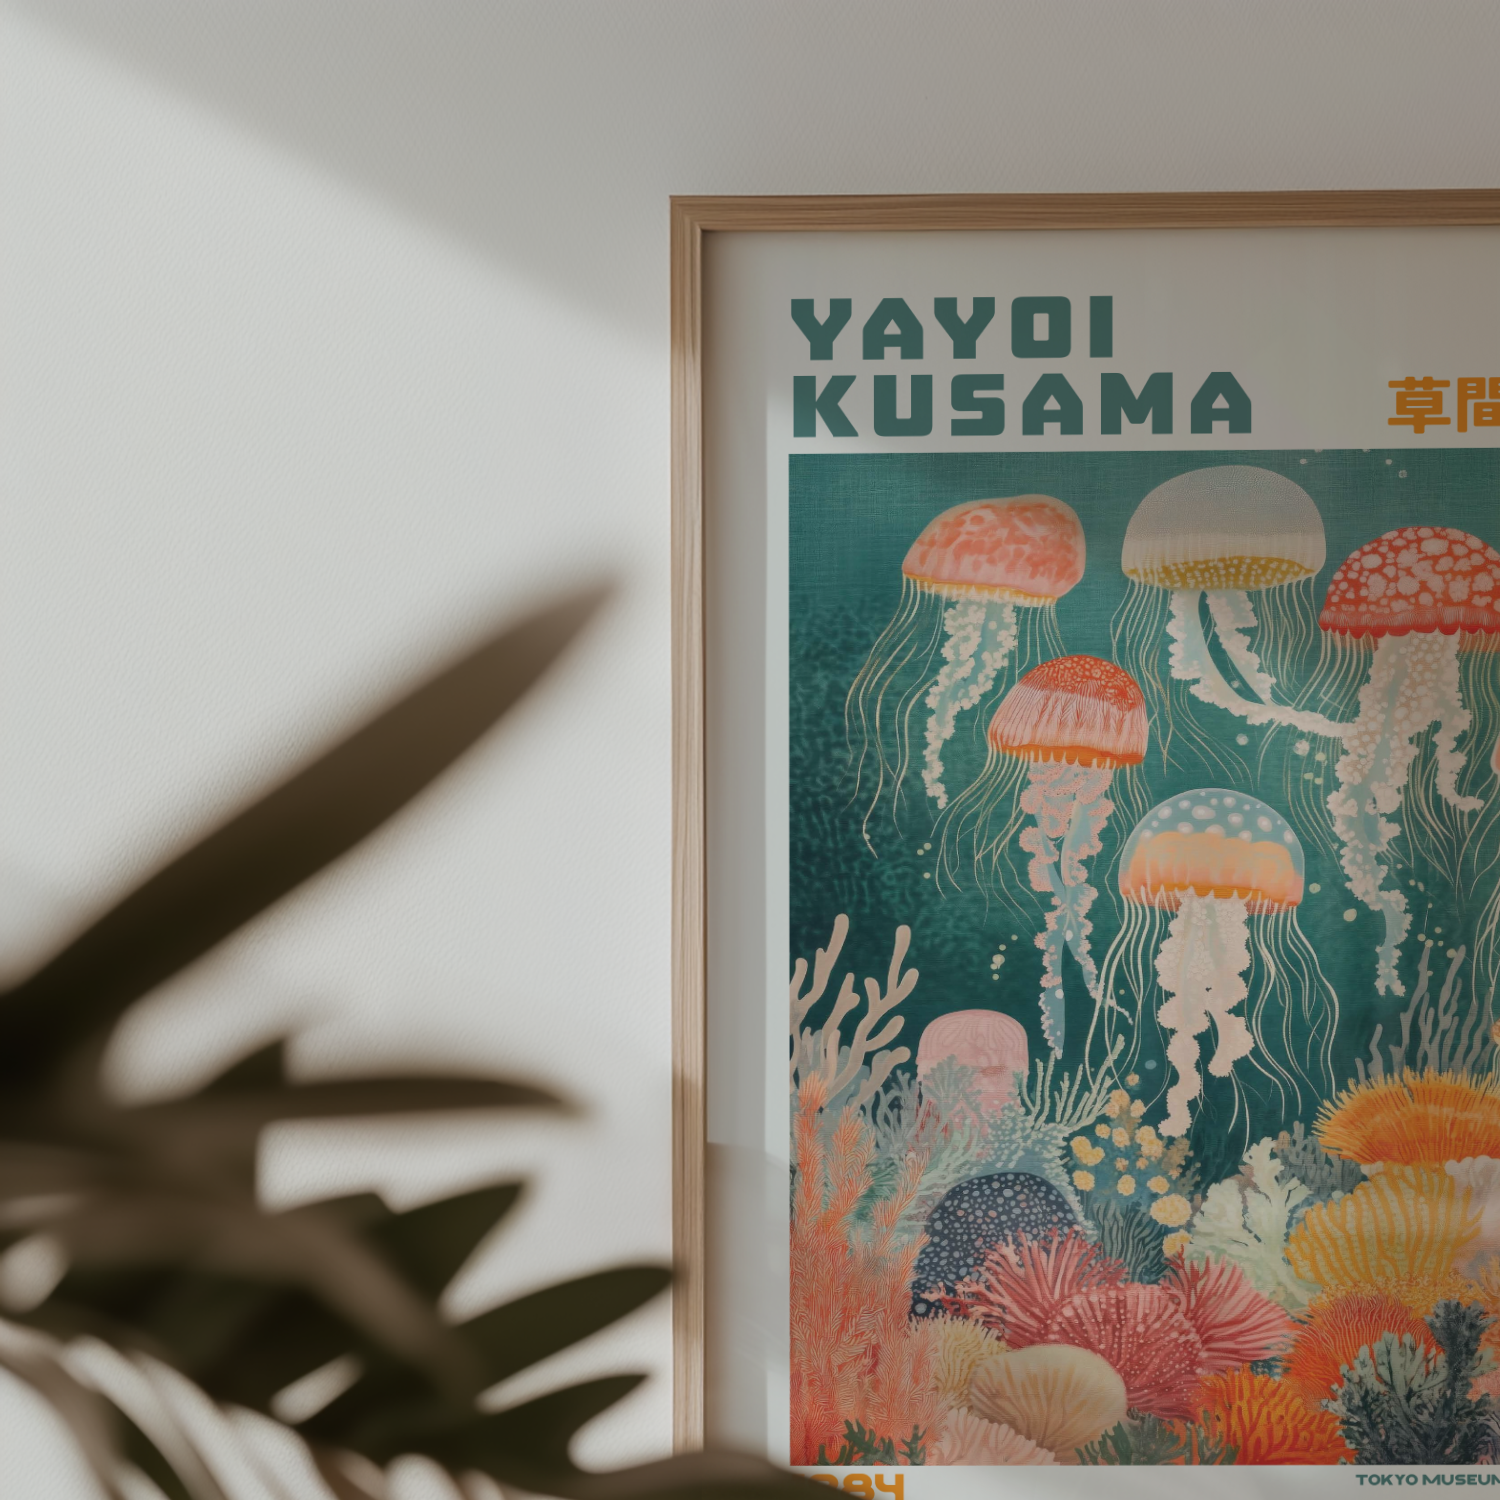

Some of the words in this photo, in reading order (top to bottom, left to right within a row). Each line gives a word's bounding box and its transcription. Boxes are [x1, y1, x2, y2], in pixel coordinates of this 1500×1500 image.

[790, 295, 1114, 361] YAYOI
[792, 371, 1252, 438] KUSAMA
[1355, 1473, 1419, 1486] TOKYO
